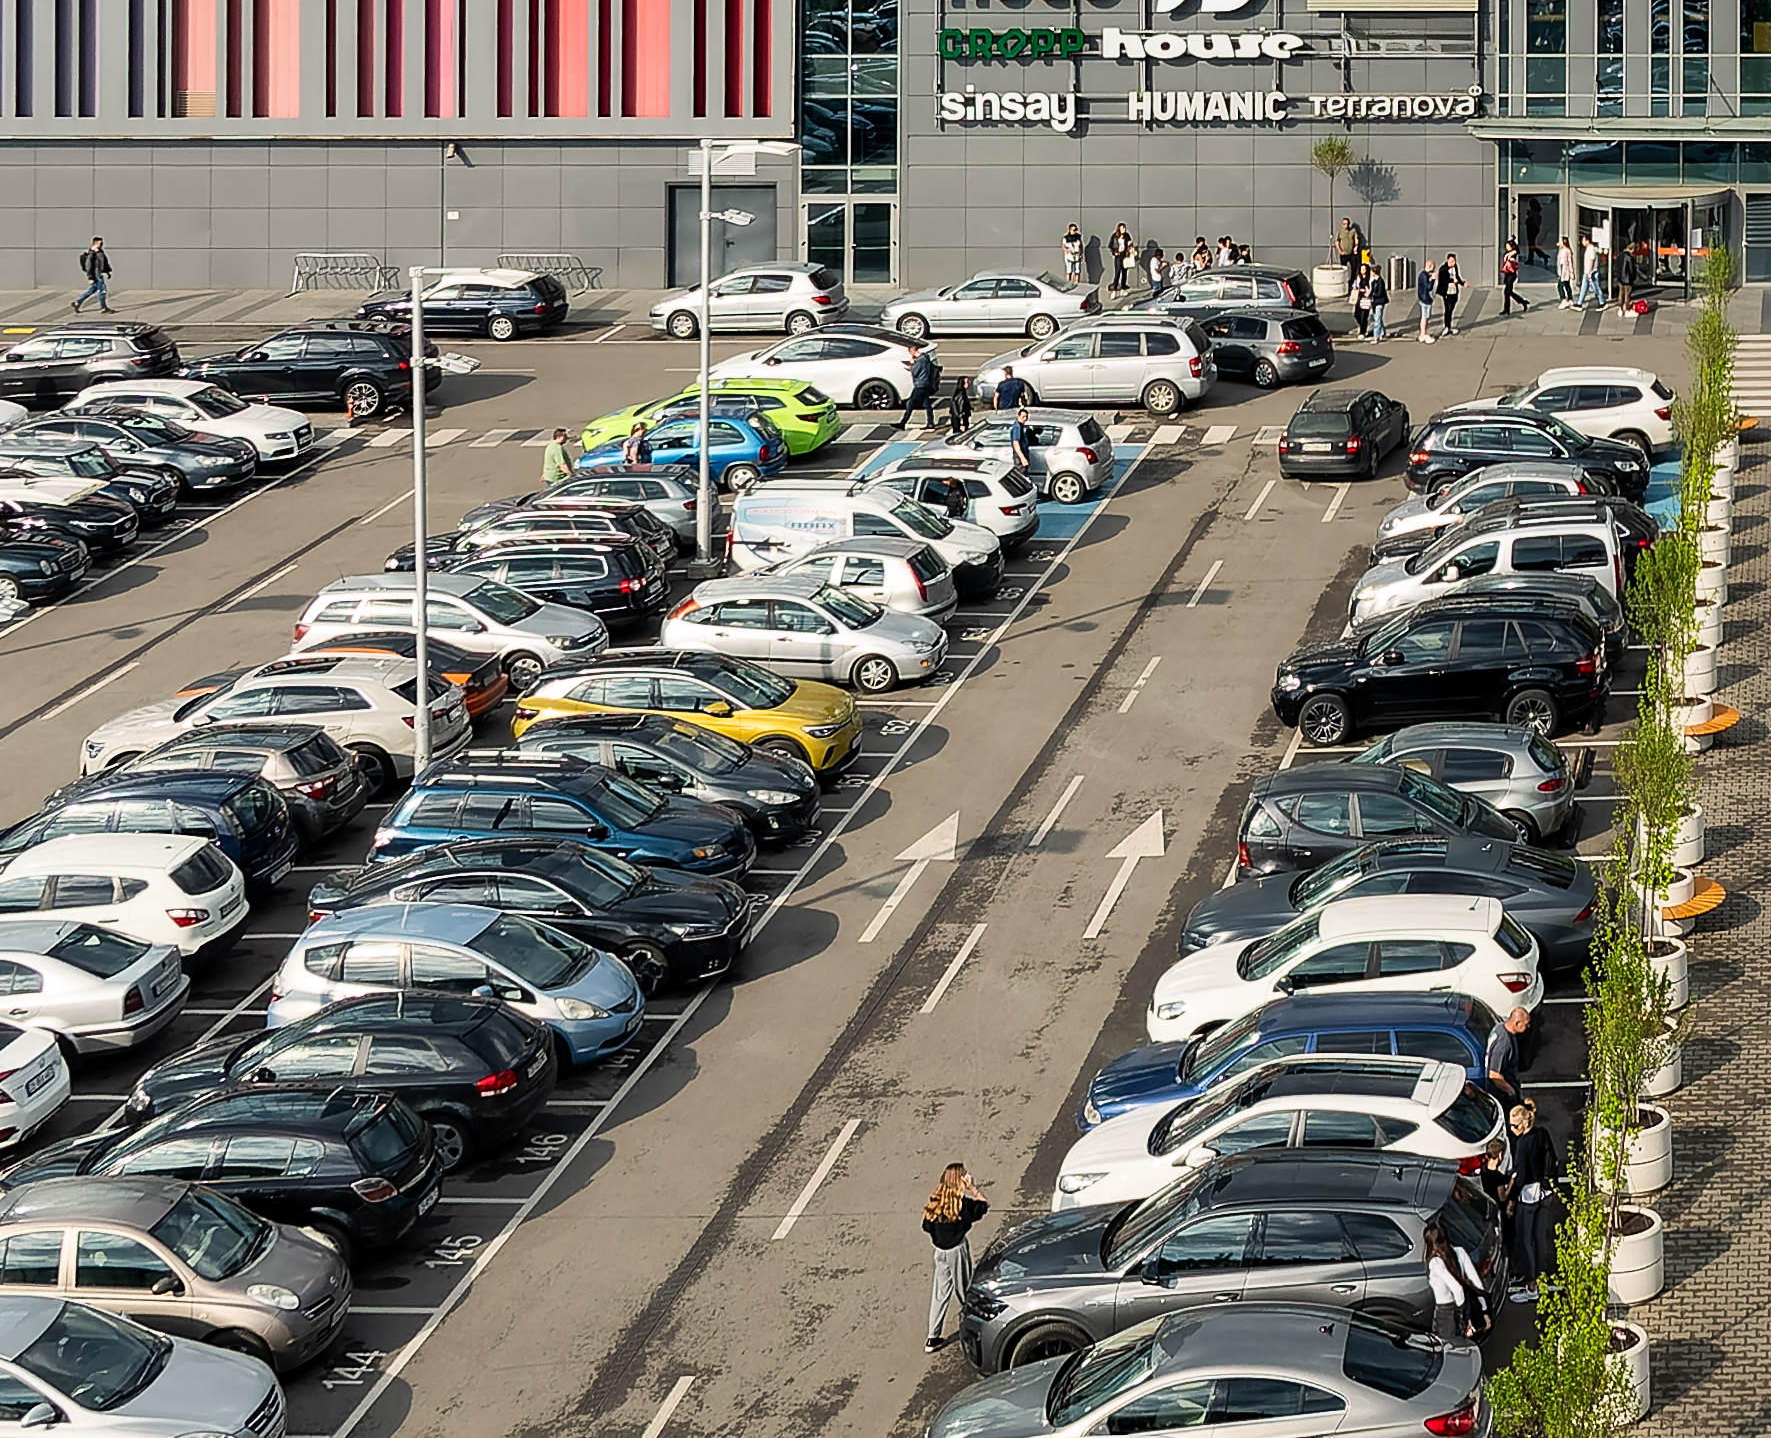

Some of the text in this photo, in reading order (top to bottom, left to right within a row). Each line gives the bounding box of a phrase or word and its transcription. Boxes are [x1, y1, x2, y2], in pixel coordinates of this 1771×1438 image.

[939, 28, 1085, 59] CROPP
[1102, 27, 1305, 60] house
[941, 83, 1077, 133] sinsay
[1128, 91, 1288, 122] HUMANIC
[880, 719, 916, 736] 152
[515, 1133, 569, 1164] 146
[424, 1235, 483, 1270] 145
[322, 1349, 388, 1390] 144
